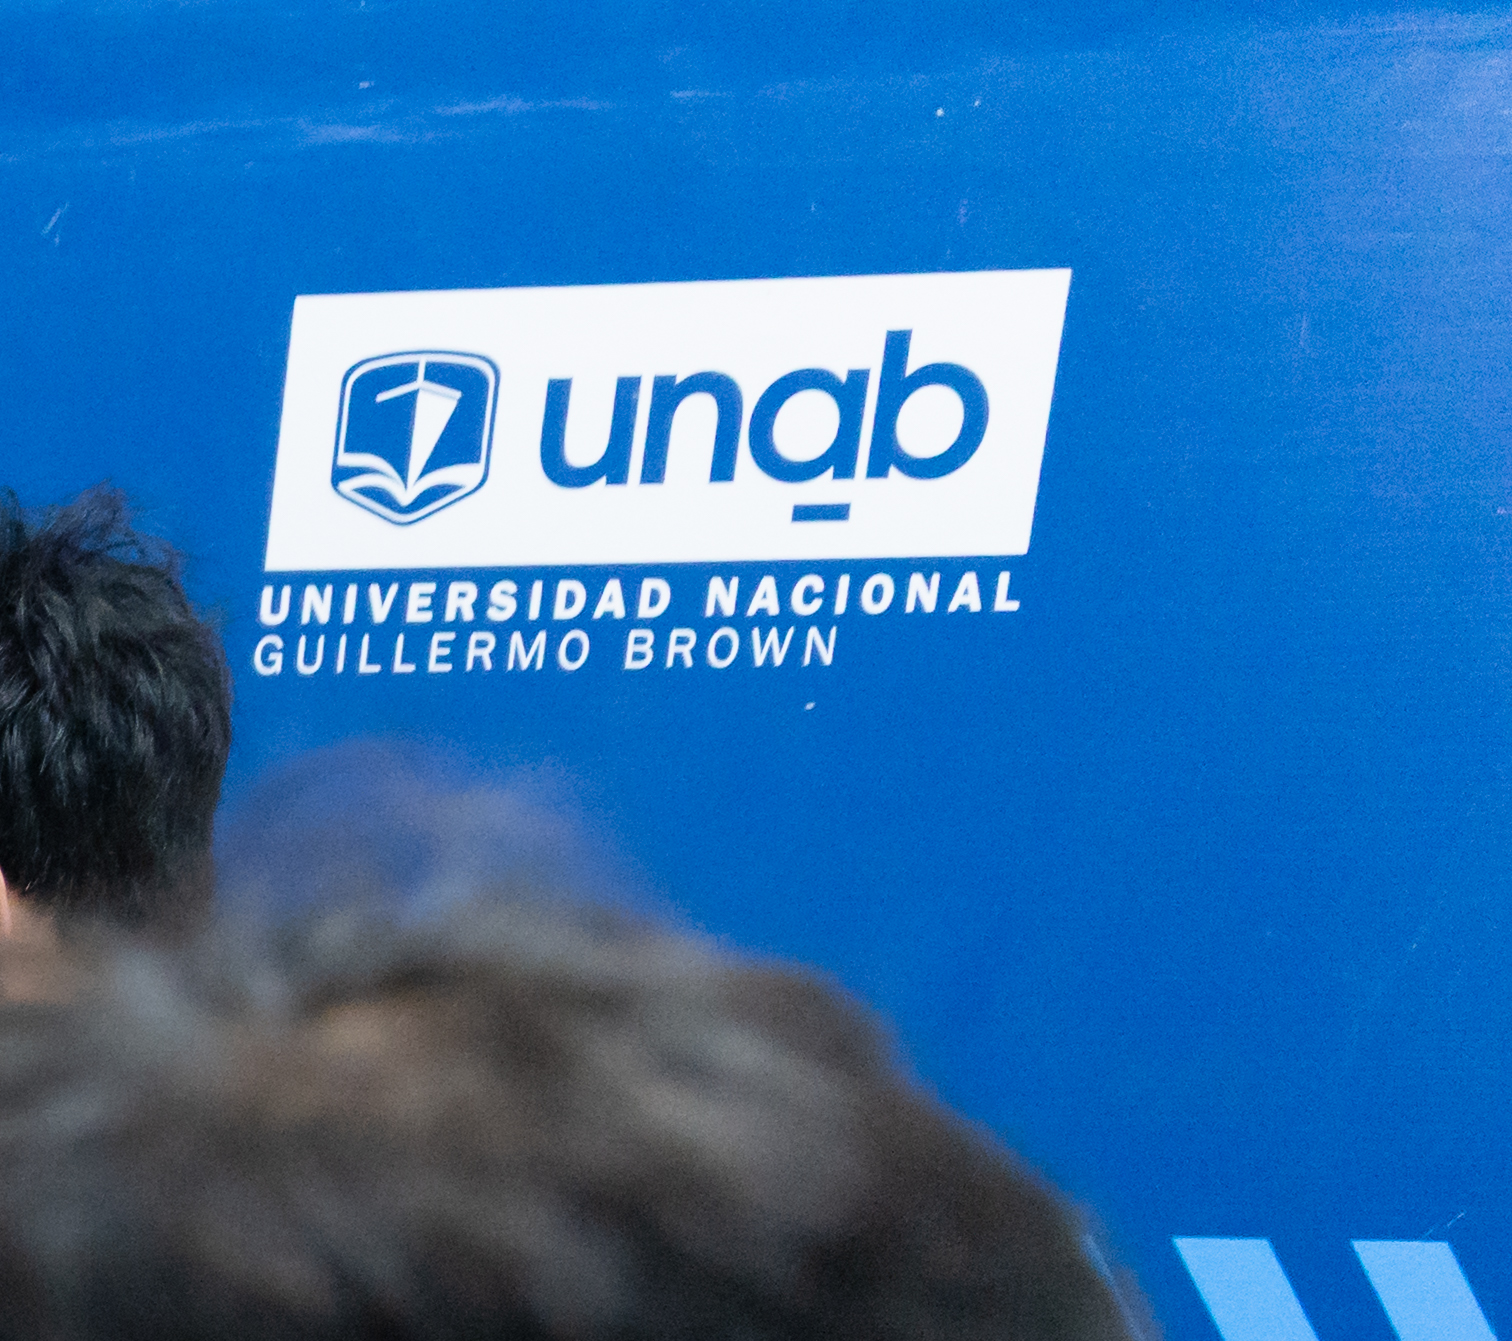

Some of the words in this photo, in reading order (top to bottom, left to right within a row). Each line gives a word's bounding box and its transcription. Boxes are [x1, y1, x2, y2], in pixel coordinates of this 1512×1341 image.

[539, 329, 990, 522] unab
[257, 577, 672, 627] UNIVERSIDAD
[704, 571, 1023, 616] NACIONAL
[252, 628, 592, 676] GUILLERMO
[623, 625, 838, 671] BROWN
